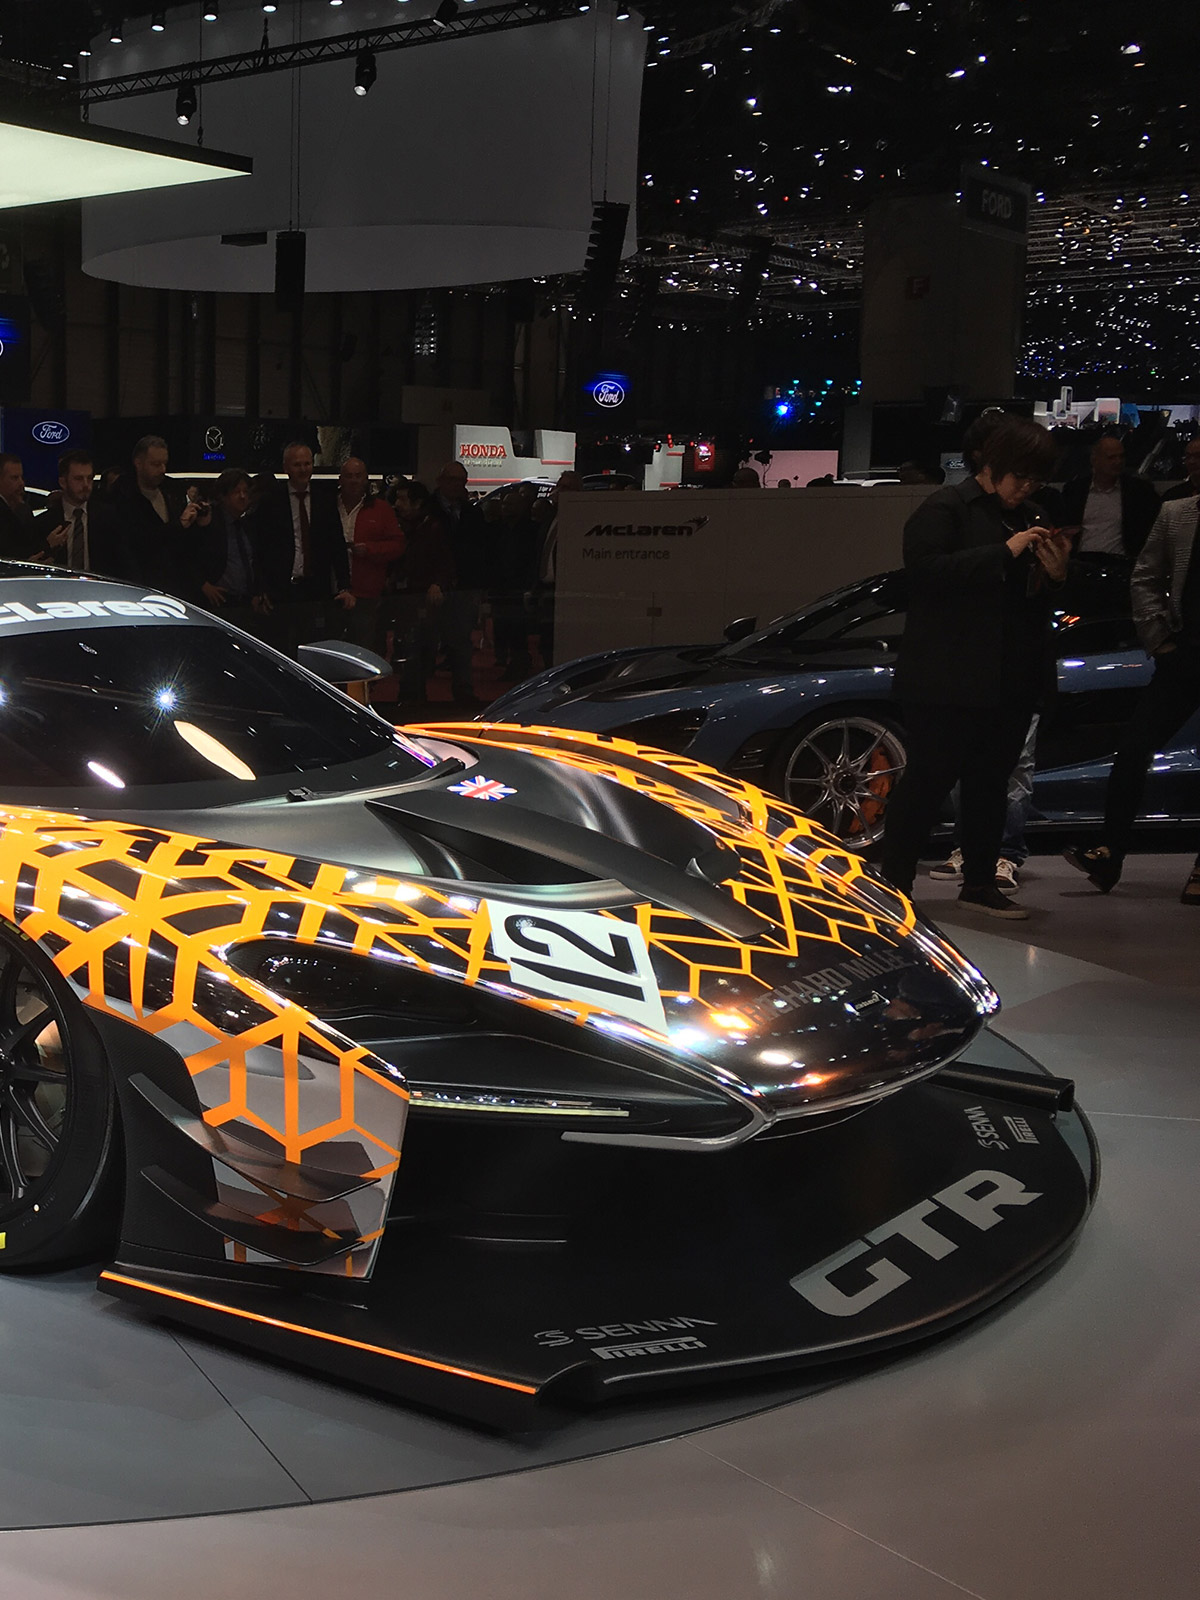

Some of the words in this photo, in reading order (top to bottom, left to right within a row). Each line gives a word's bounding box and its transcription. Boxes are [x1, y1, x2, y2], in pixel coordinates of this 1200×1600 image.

[460, 443, 507, 458] HONDA
[584, 524, 694, 537] McLaren
[582, 547, 611, 560] Main
[615, 548, 670, 560] entrance
[504, 914, 647, 1003] 12
[839, 949, 916, 981] MILLE
[789, 1169, 1044, 1317] GTR
[575, 1316, 719, 1340] SENNA
[590, 1335, 708, 1361] PIRELLI
